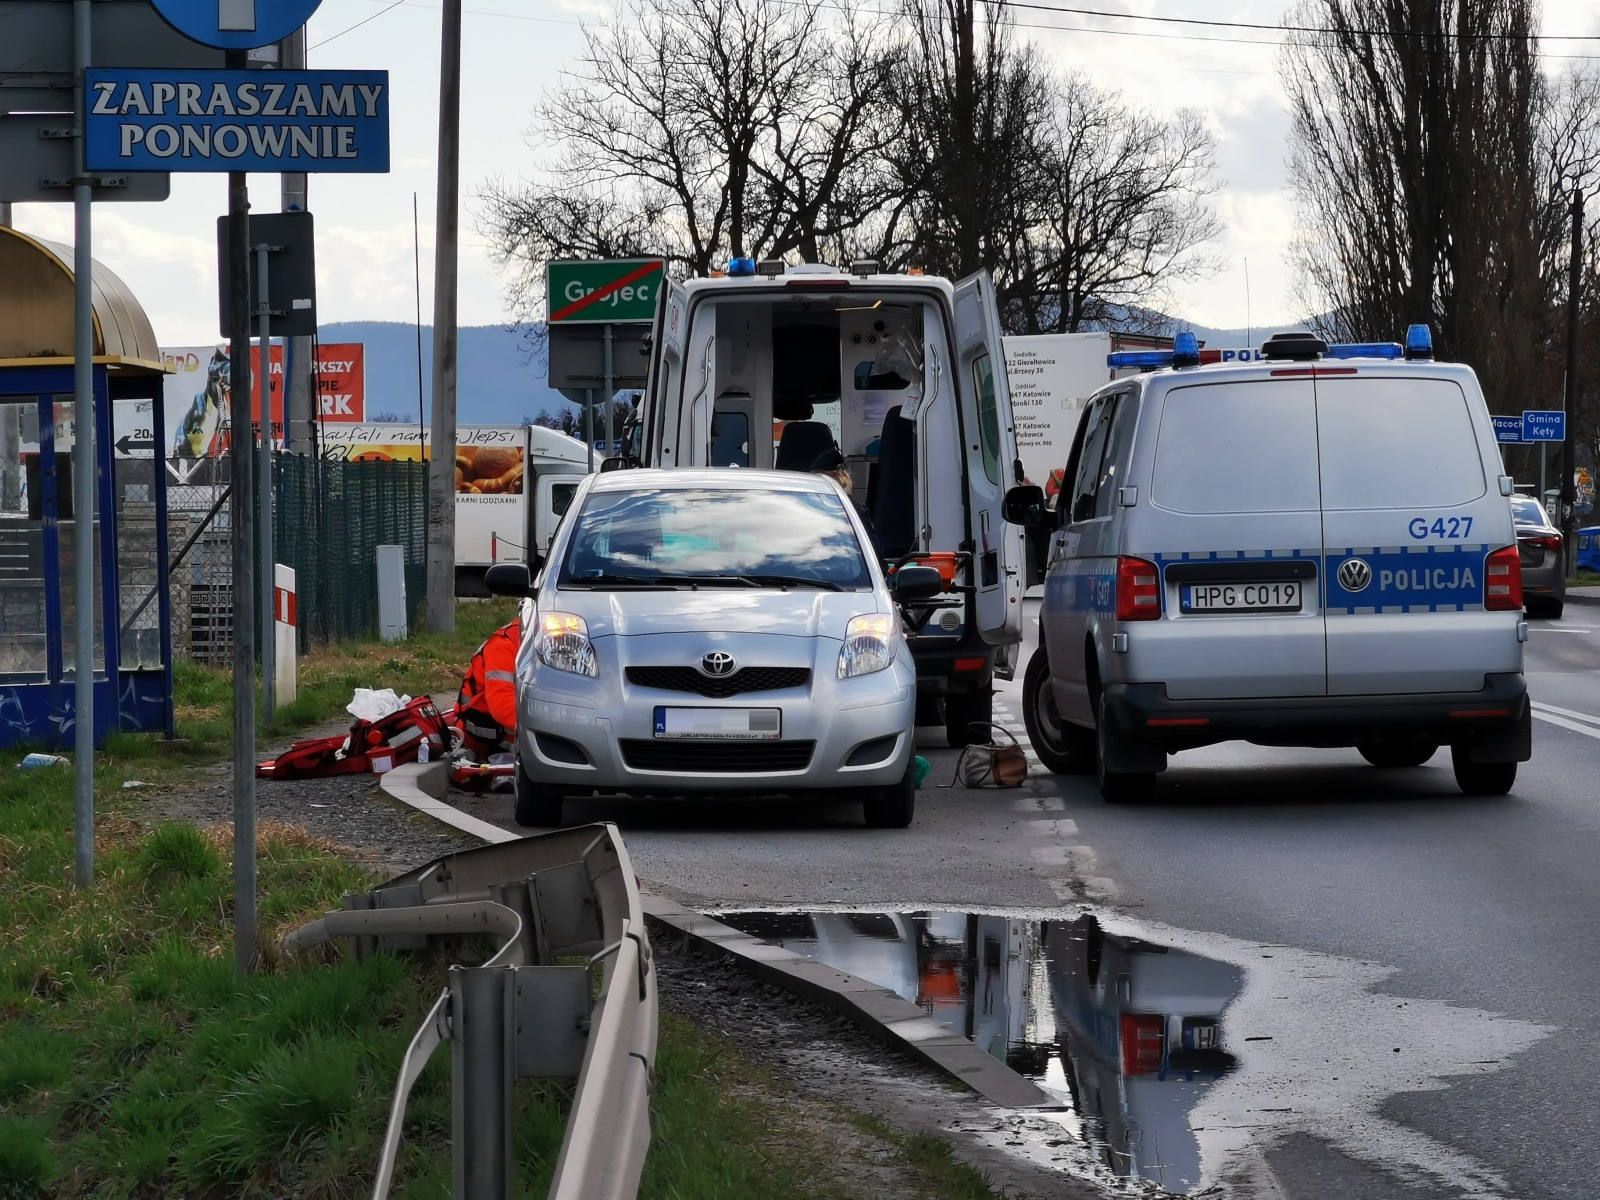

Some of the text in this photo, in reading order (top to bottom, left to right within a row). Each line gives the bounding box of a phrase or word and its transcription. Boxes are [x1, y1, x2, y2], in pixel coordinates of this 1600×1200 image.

[91, 82, 383, 117] ZAPRASZAMY
[119, 124, 358, 158] PONOWNIE
[1527, 414, 1561, 423] Gmina
[391, 431, 429, 441] nam
[1532, 426, 1555, 437] Kęty
[1408, 517, 1473, 539] G427
[1379, 567, 1476, 591] POLICJA
[1195, 586, 1236, 608] HPG
[1244, 584, 1295, 605] C019
